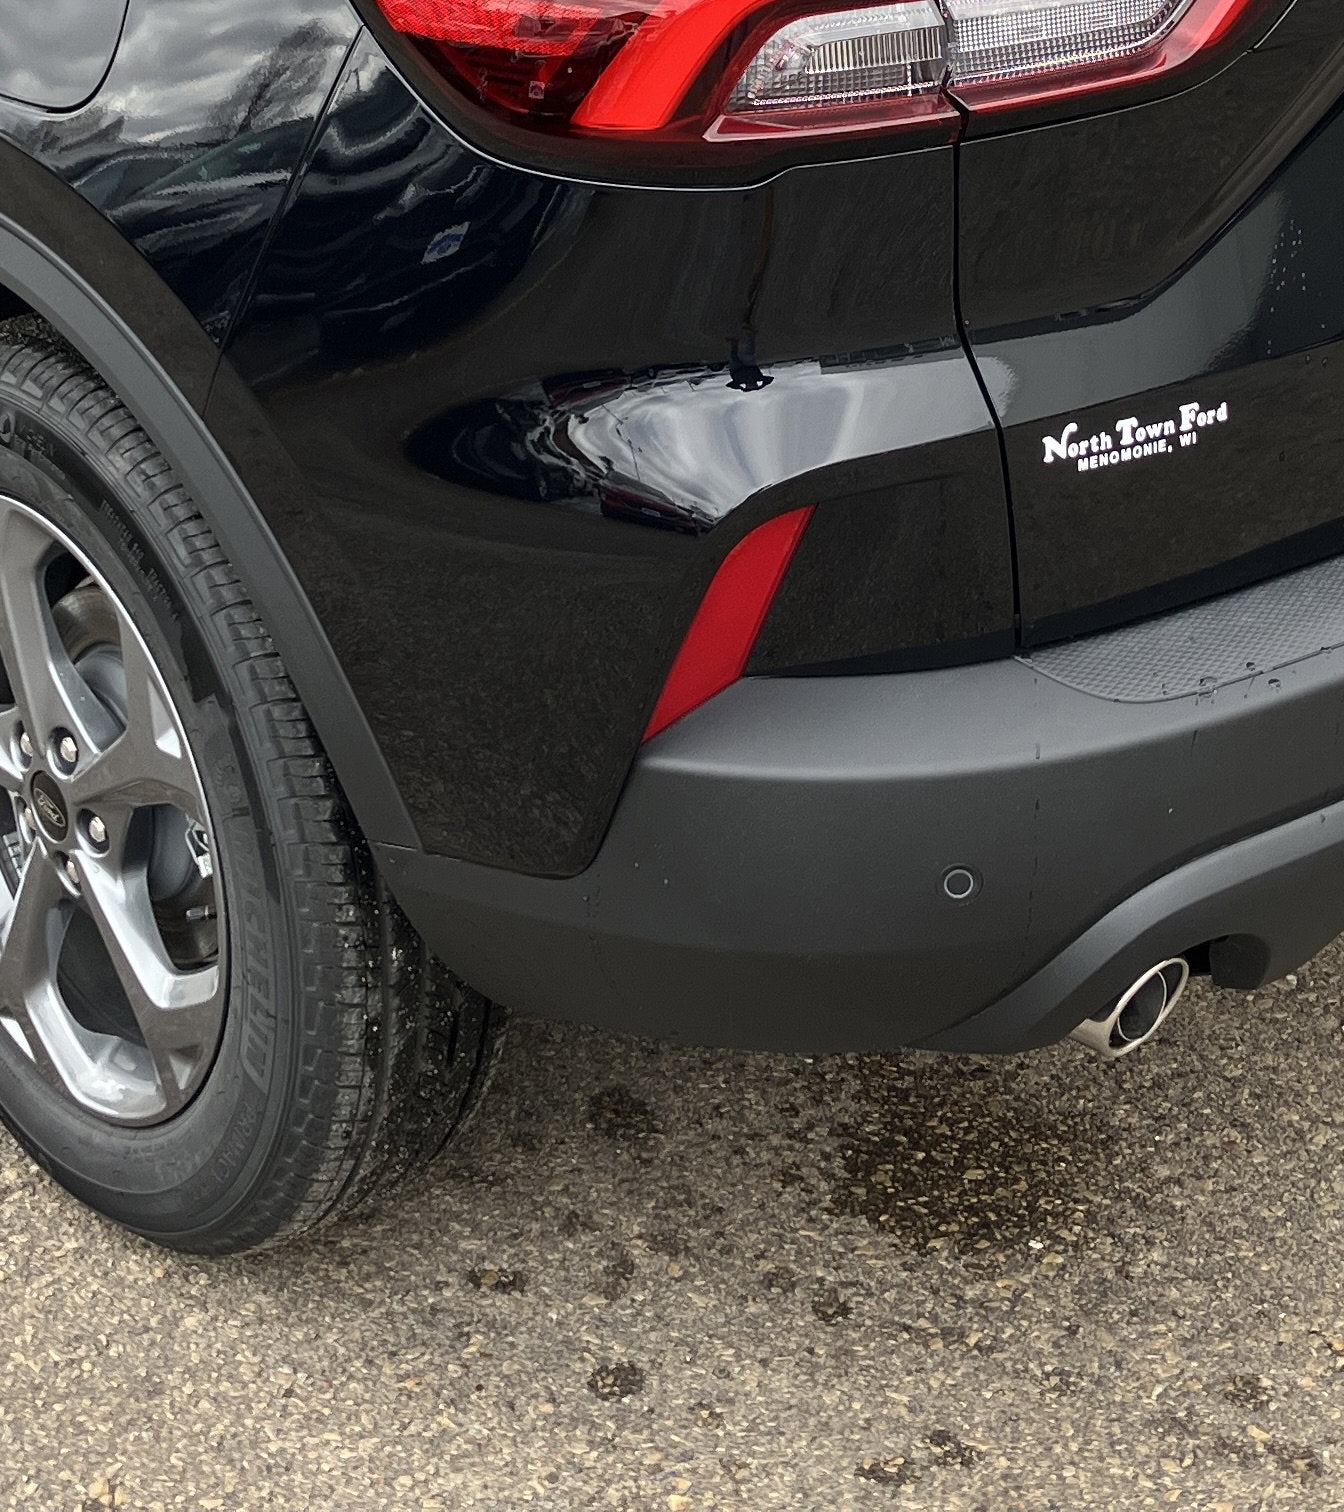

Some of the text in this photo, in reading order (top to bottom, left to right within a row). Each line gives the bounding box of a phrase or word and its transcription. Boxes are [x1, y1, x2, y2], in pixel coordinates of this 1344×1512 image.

[1041, 400, 1229, 464] North Town Ford
[1076, 431, 1198, 472] MENOMONIE, WI
